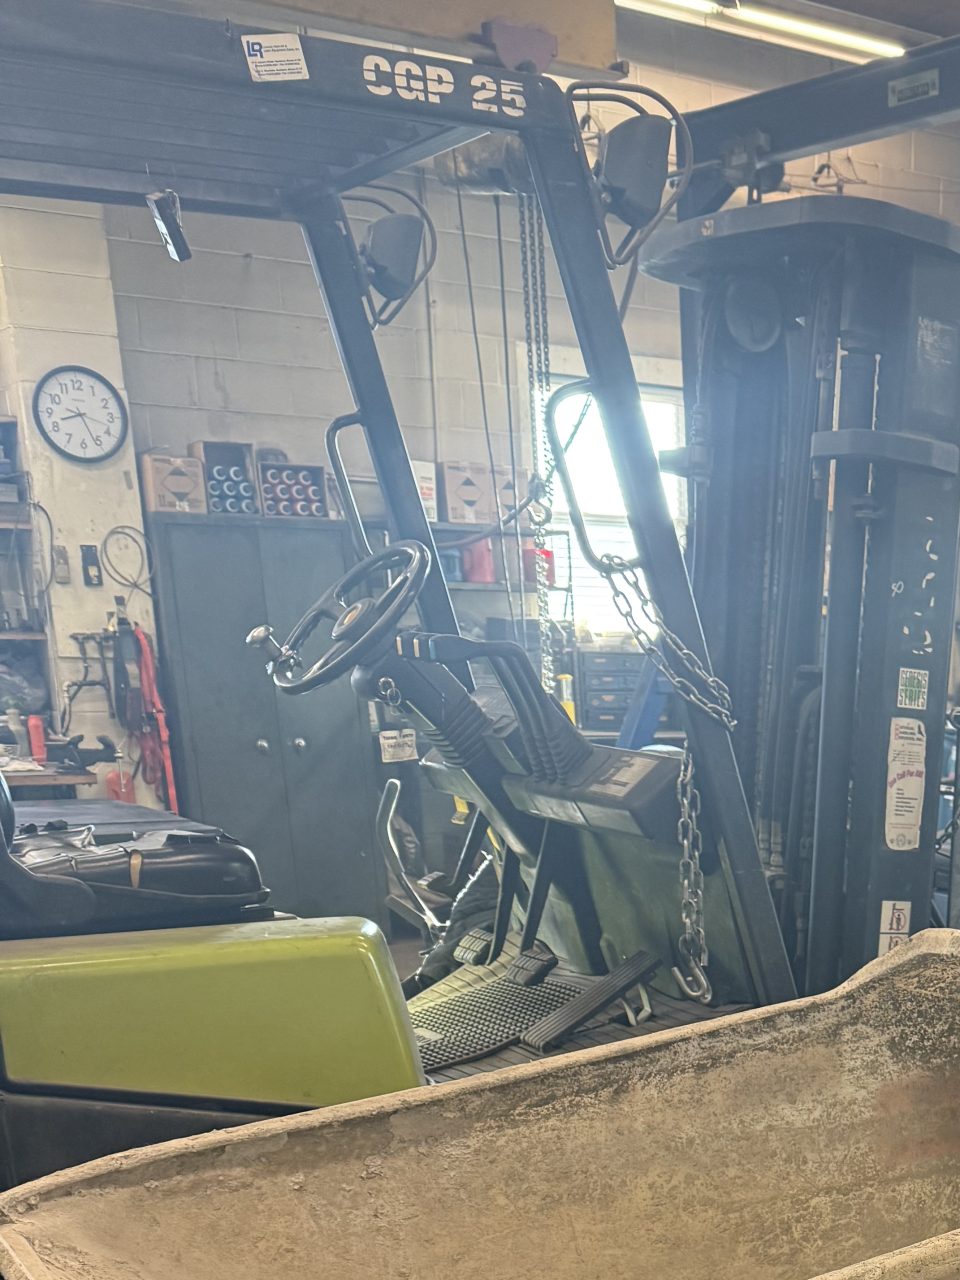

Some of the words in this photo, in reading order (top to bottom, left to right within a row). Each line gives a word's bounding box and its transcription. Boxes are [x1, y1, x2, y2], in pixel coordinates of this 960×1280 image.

[363, 55, 454, 104] CGP
[470, 75, 527, 117] 25
[59, 383, 68, 394] 11
[70, 379, 83, 391] 12
[89, 385, 96, 397] 1
[49, 393, 61, 405] 10
[100, 398, 109, 409] 2
[46, 407, 53, 418] 9
[106, 412, 115, 424] 3
[52, 421, 60, 432] 8
[103, 425, 111, 437] 4
[65, 432, 73, 444] 7
[80, 438, 88, 450] 6
[95, 435, 103, 446] 5
